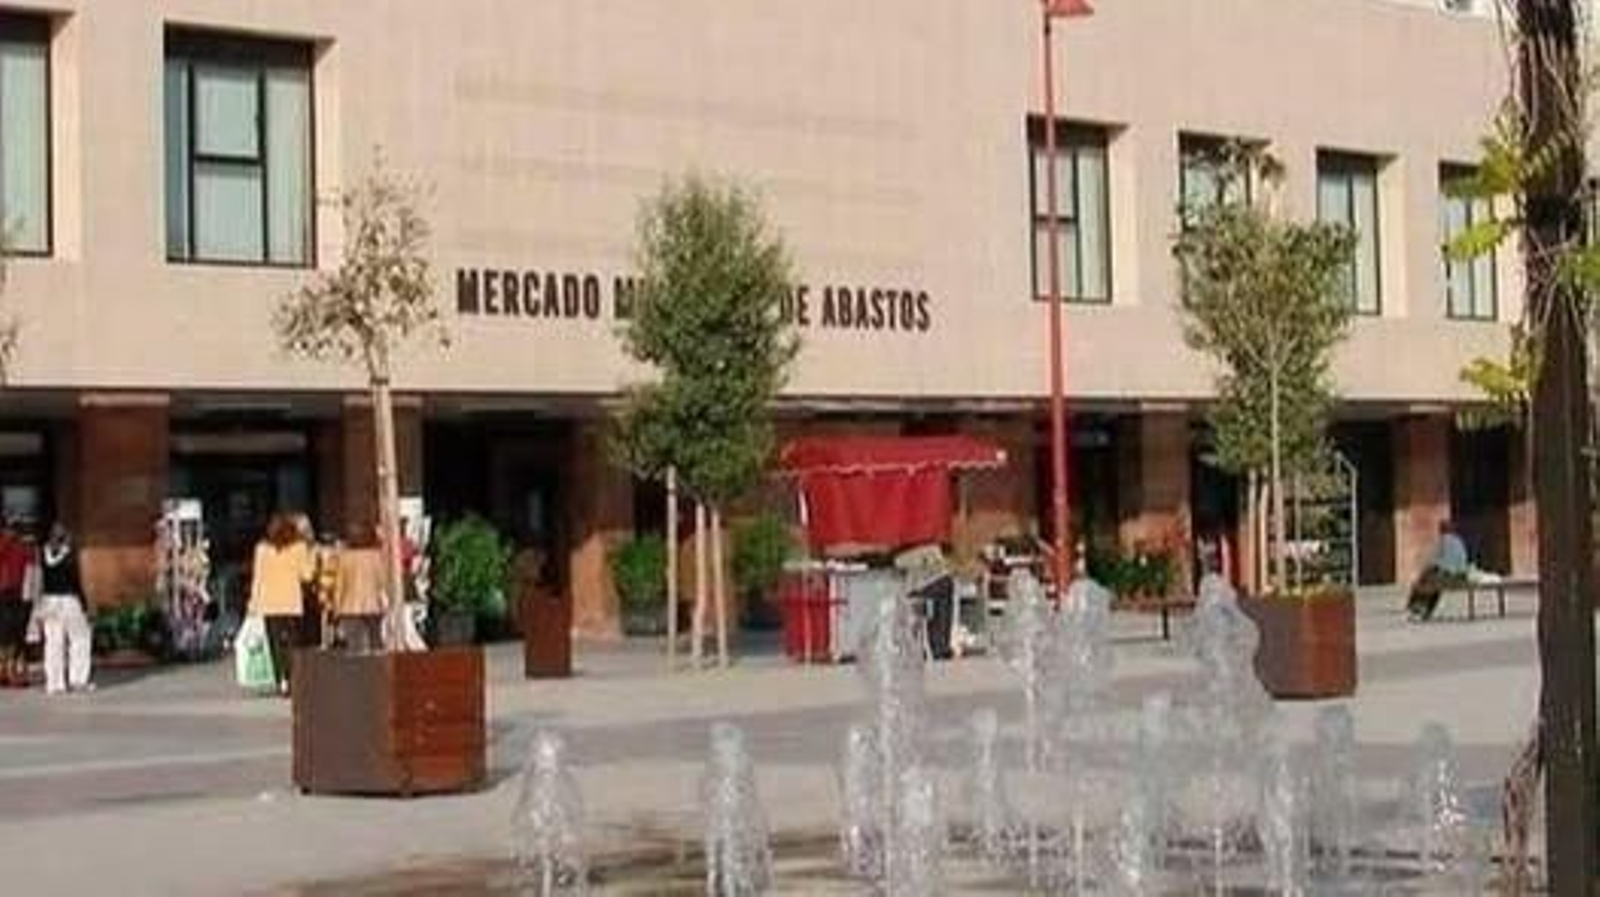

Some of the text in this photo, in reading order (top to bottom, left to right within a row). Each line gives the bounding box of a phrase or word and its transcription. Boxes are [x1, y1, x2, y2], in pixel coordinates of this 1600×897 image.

[456, 268, 599, 319] MERCADO
[780, 286, 810, 326] DE
[822, 286, 930, 332] ABASTOS
